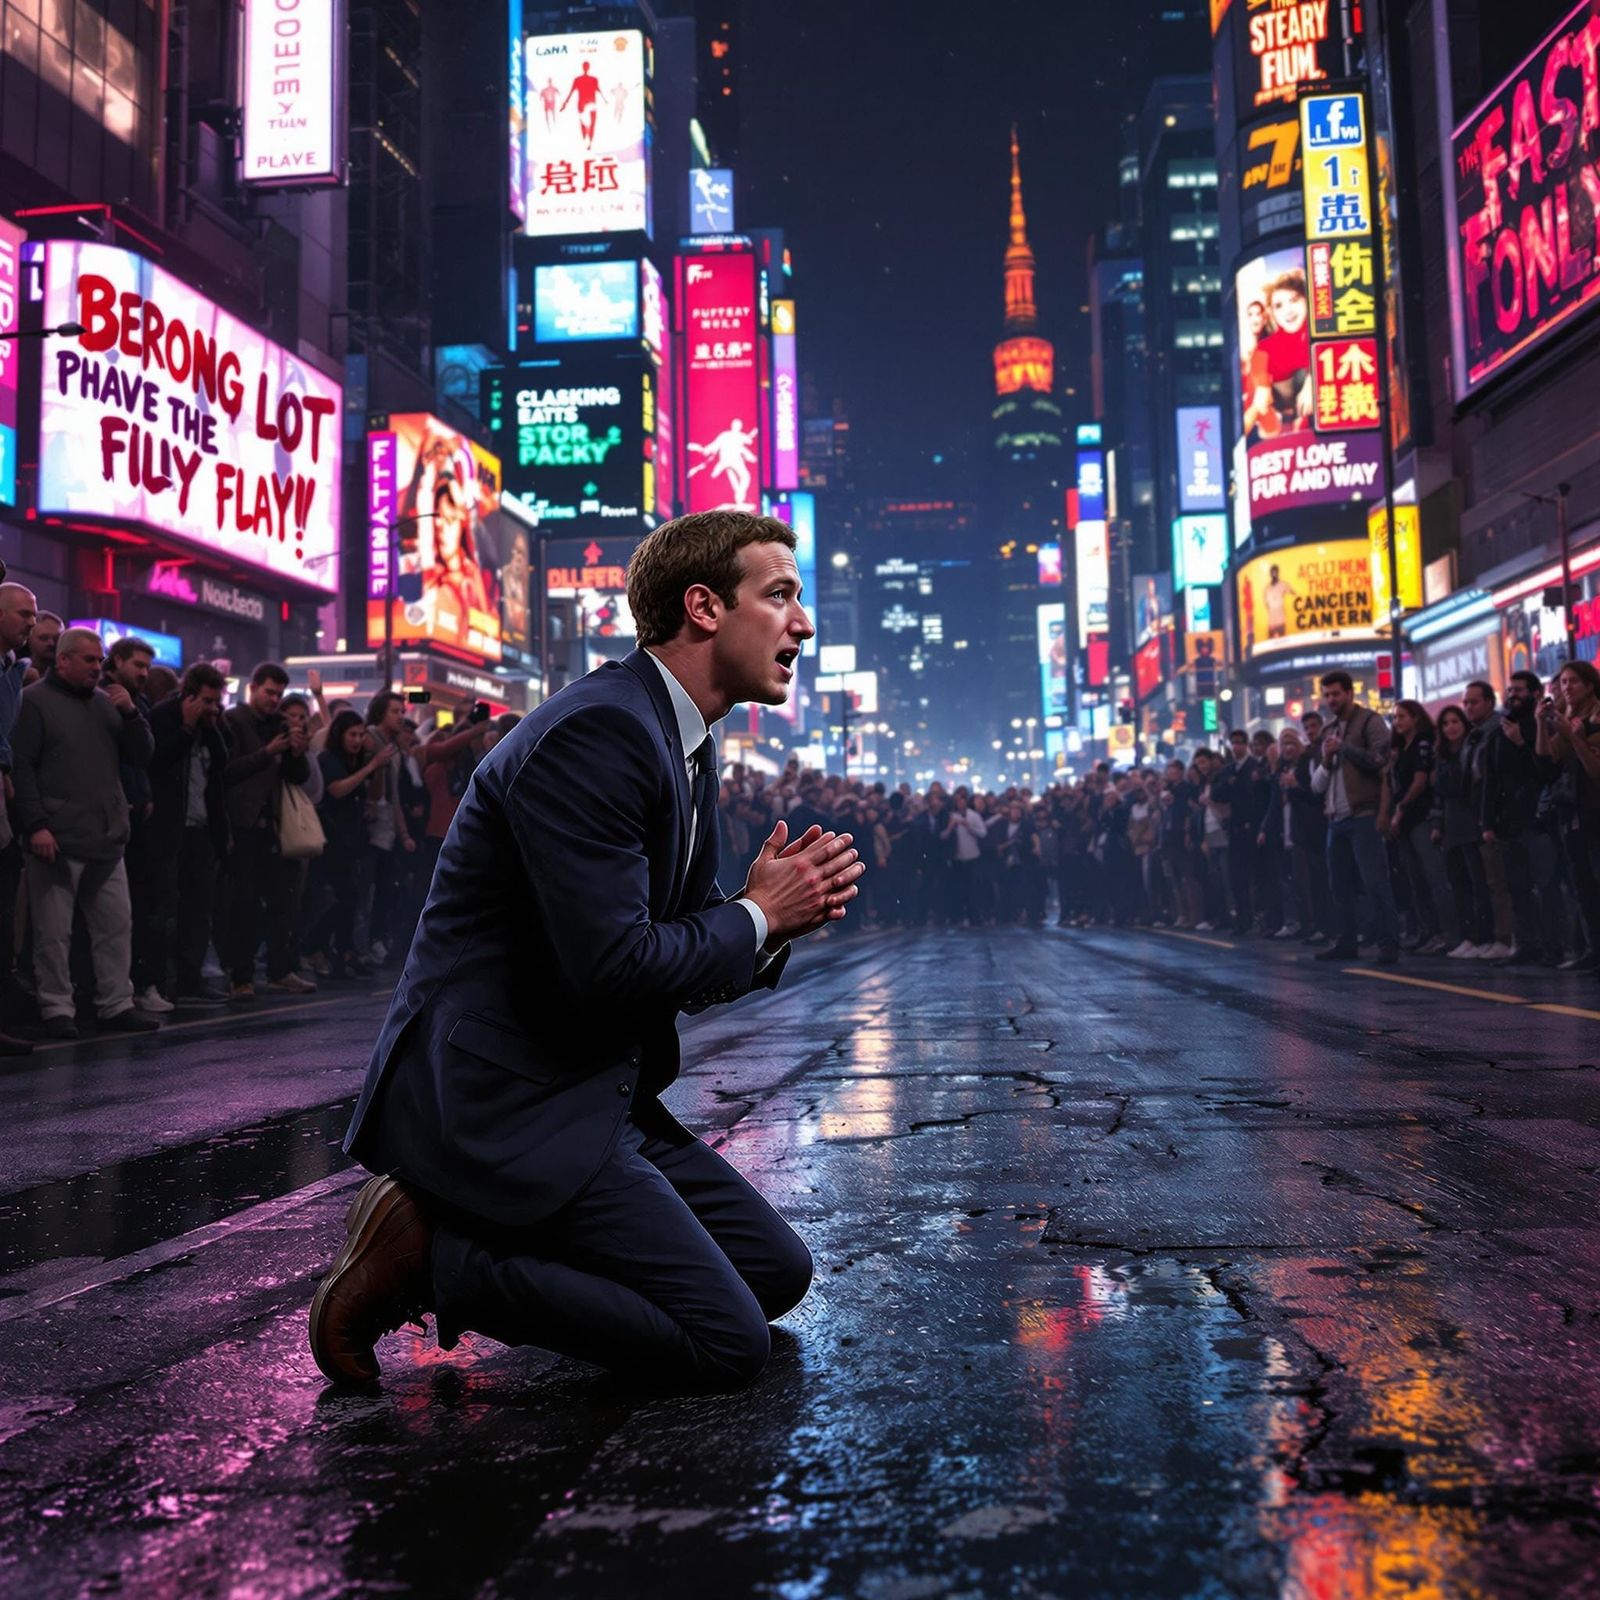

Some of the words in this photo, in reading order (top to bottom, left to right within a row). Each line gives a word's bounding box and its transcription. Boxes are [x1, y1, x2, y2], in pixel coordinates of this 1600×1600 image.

[78, 274, 244, 424] BERONG
[256, 373, 335, 464] LOT
[57, 351, 159, 422] PHAVE
[167, 397, 218, 455] THE
[519, 440, 609, 466] PACKY
[1296, 442, 1347, 468] LOVE
[1332, 462, 1378, 487] WAY
